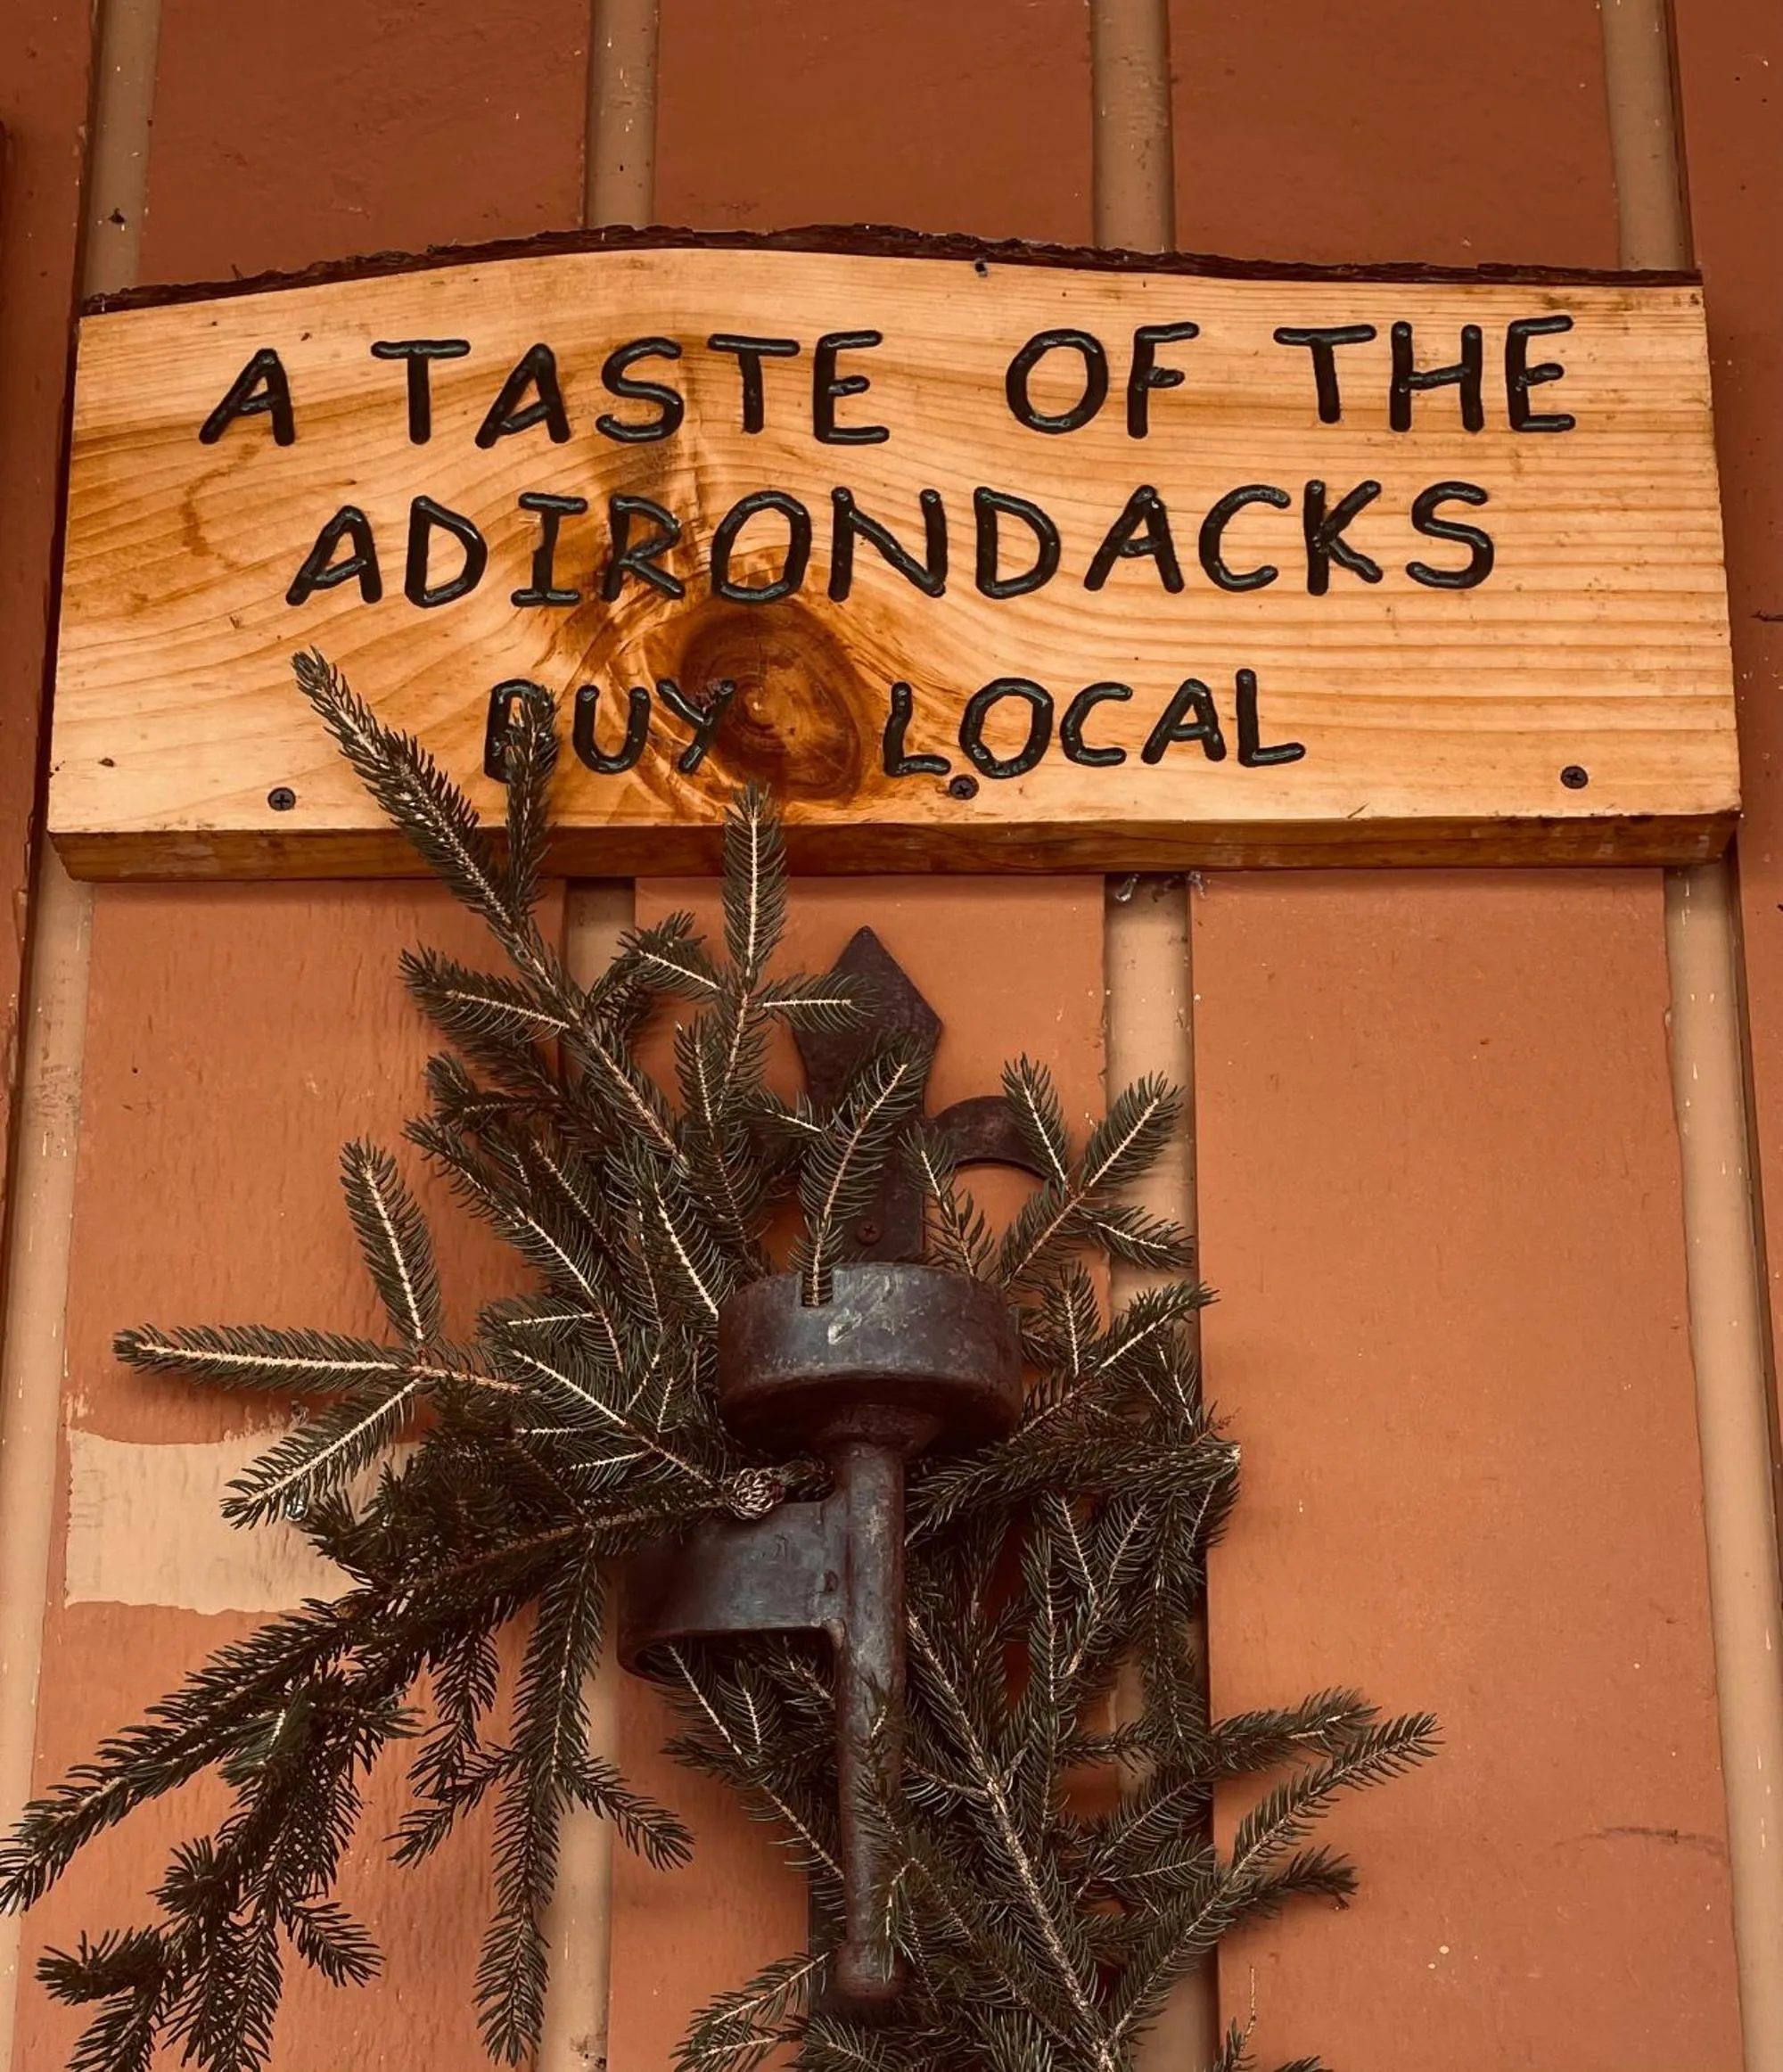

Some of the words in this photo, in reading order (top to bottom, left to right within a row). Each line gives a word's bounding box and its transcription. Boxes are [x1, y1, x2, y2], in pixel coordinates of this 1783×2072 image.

[199, 349, 296, 447] A
[372, 330, 890, 448] TASTE
[1005, 321, 1200, 439] OF
[1273, 315, 1576, 432] THE
[286, 480, 1494, 608] ADIRONDACKS
[883, 668, 1306, 779] LOCAL
